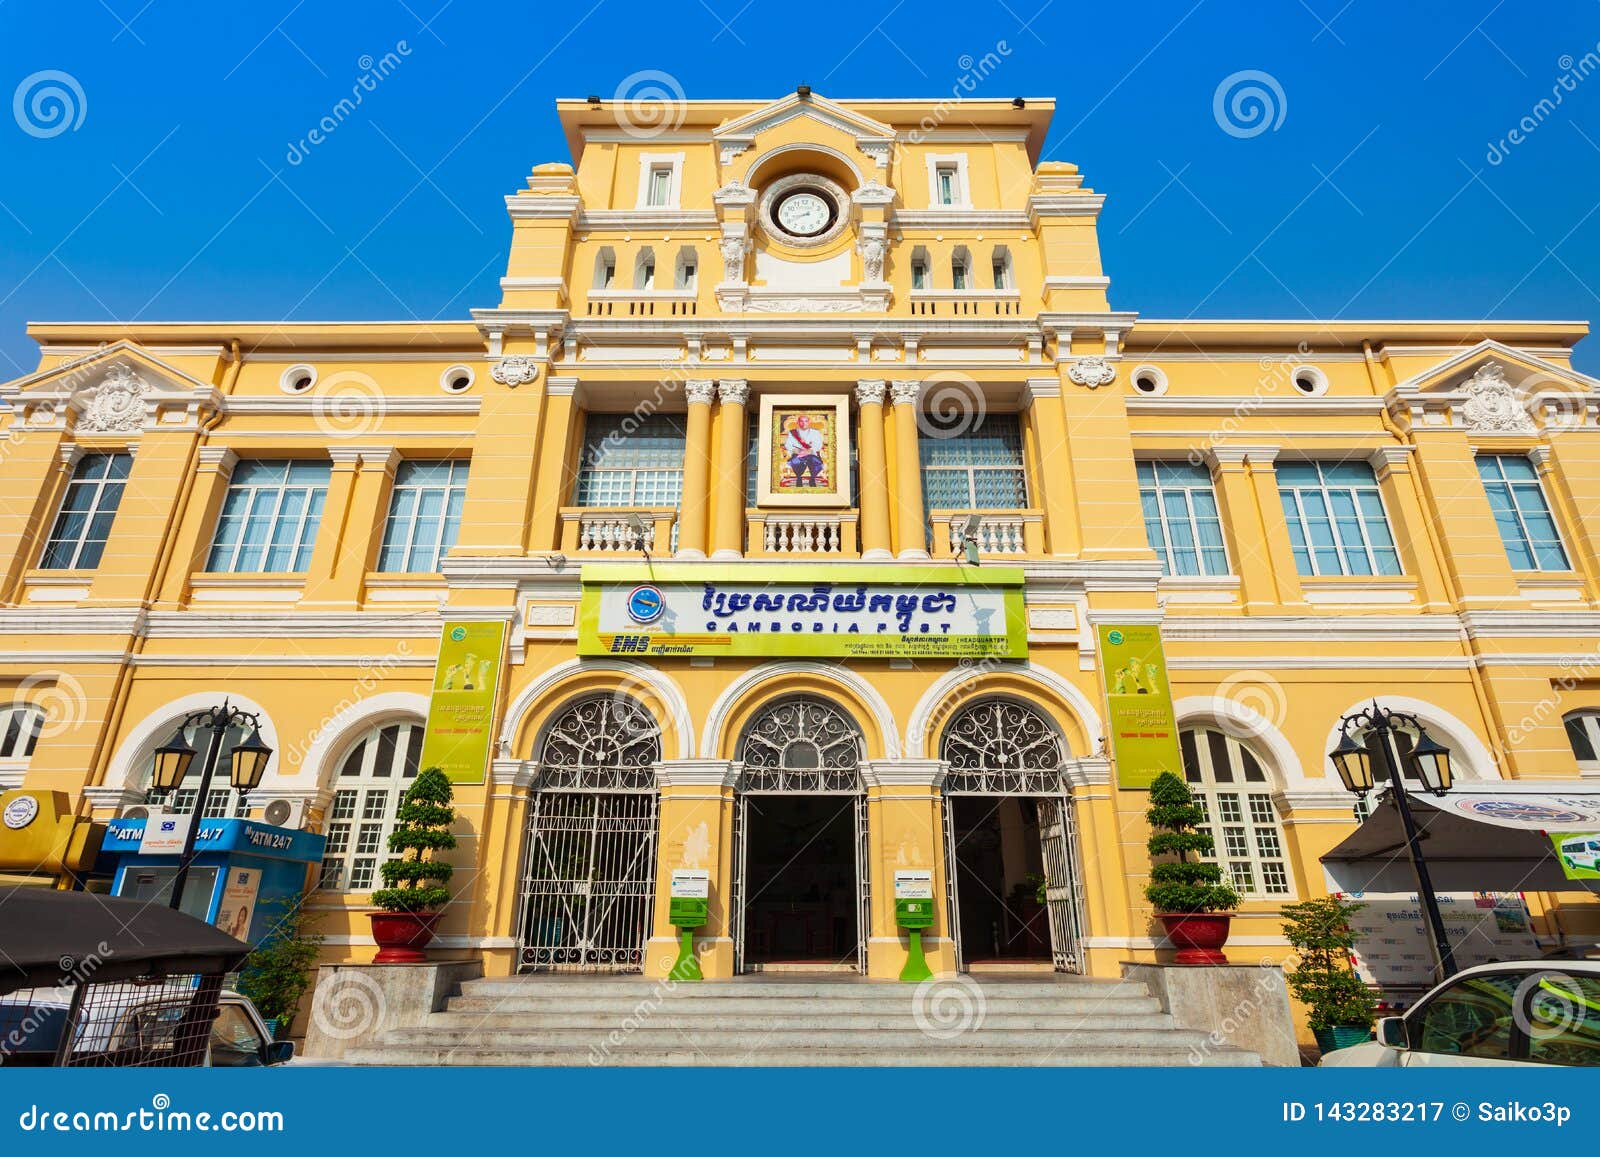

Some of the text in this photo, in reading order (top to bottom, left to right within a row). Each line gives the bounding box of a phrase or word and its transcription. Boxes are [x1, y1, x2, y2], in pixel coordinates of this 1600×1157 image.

[706, 621, 951, 633] CAMBODIA POST
[610, 635, 650, 652] EMS
[271, 834, 293, 850] 24/7
